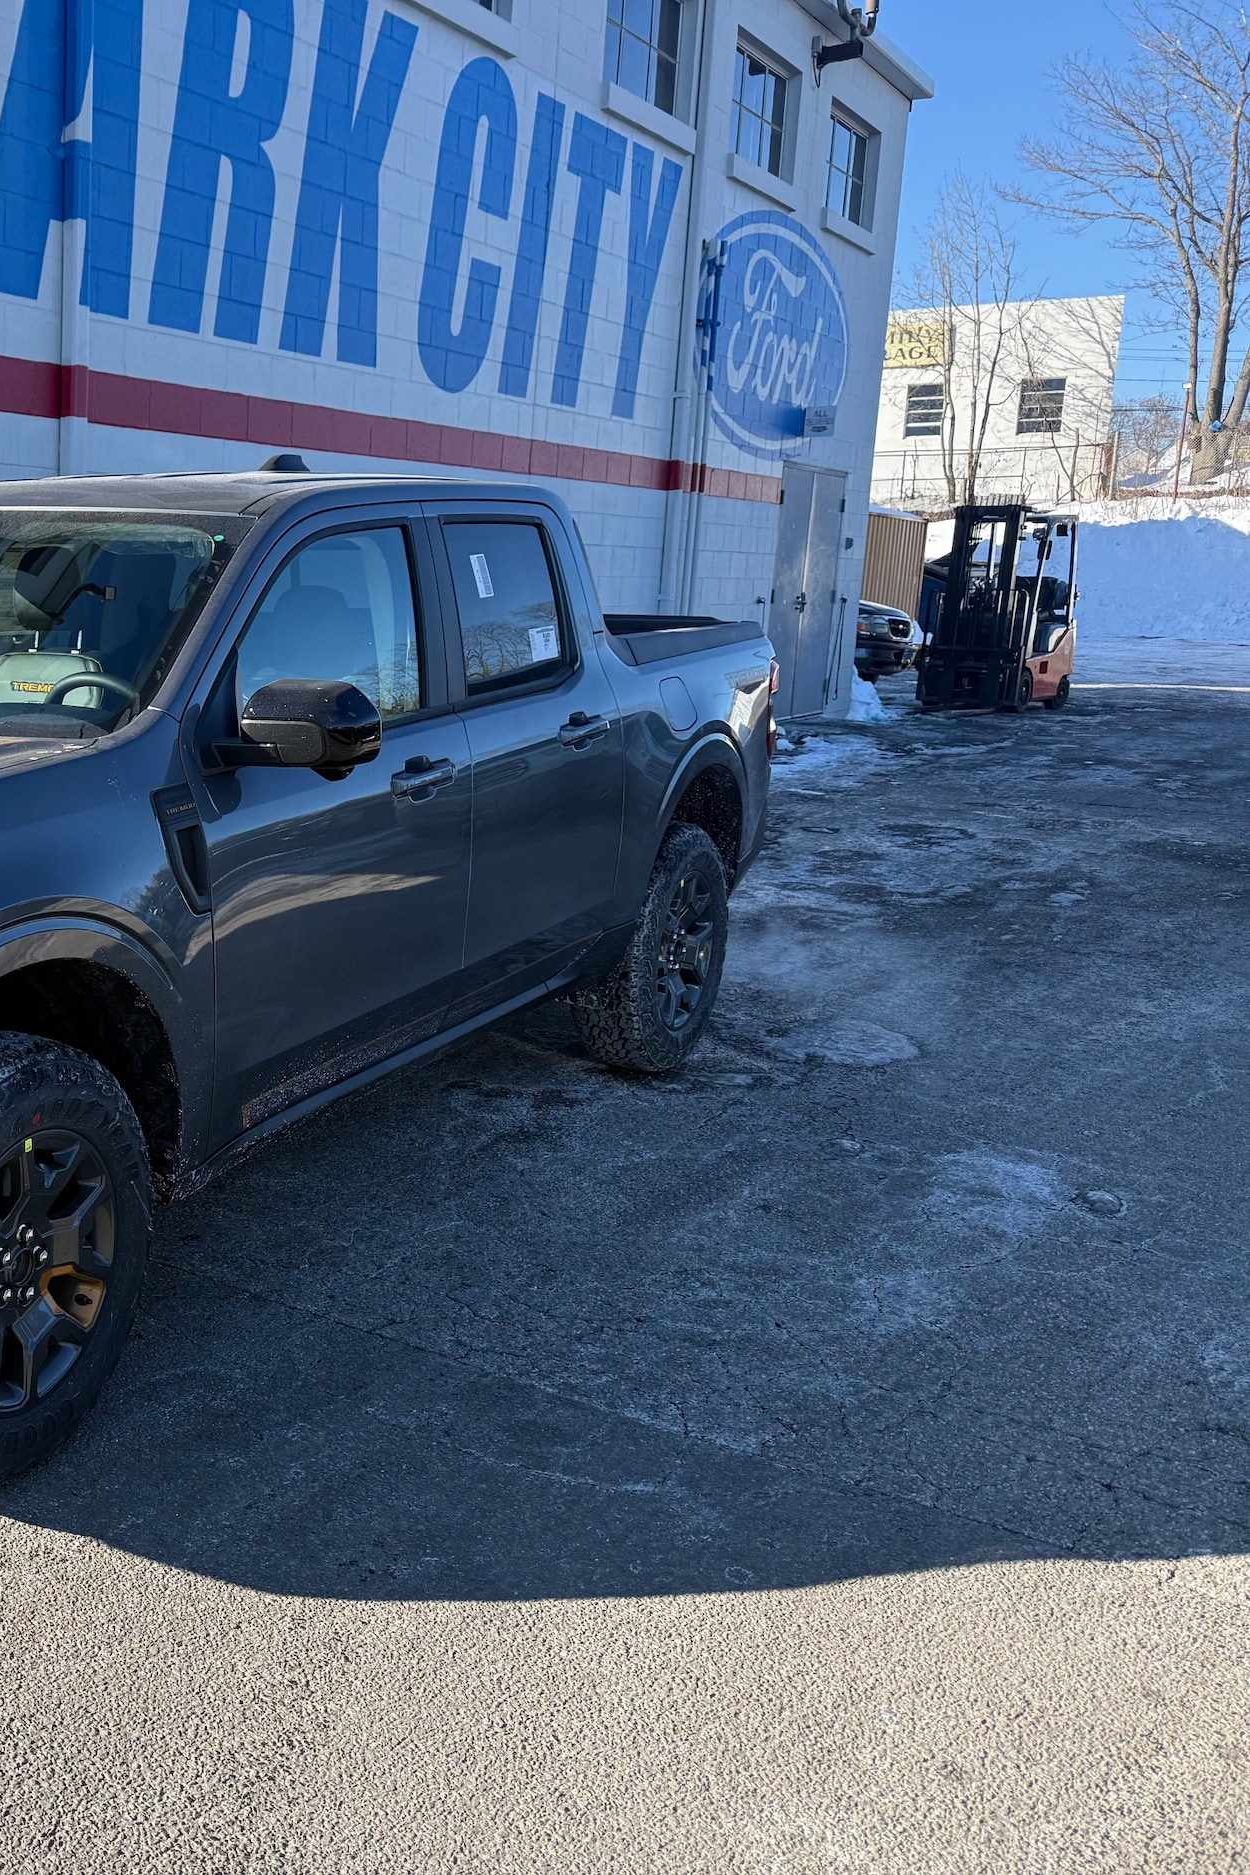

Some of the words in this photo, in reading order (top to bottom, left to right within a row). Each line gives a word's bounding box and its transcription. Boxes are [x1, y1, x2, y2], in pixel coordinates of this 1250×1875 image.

[417, 56, 683, 420] CITY
[727, 249, 824, 408] Ford
[813, 410, 828, 418] ALL
